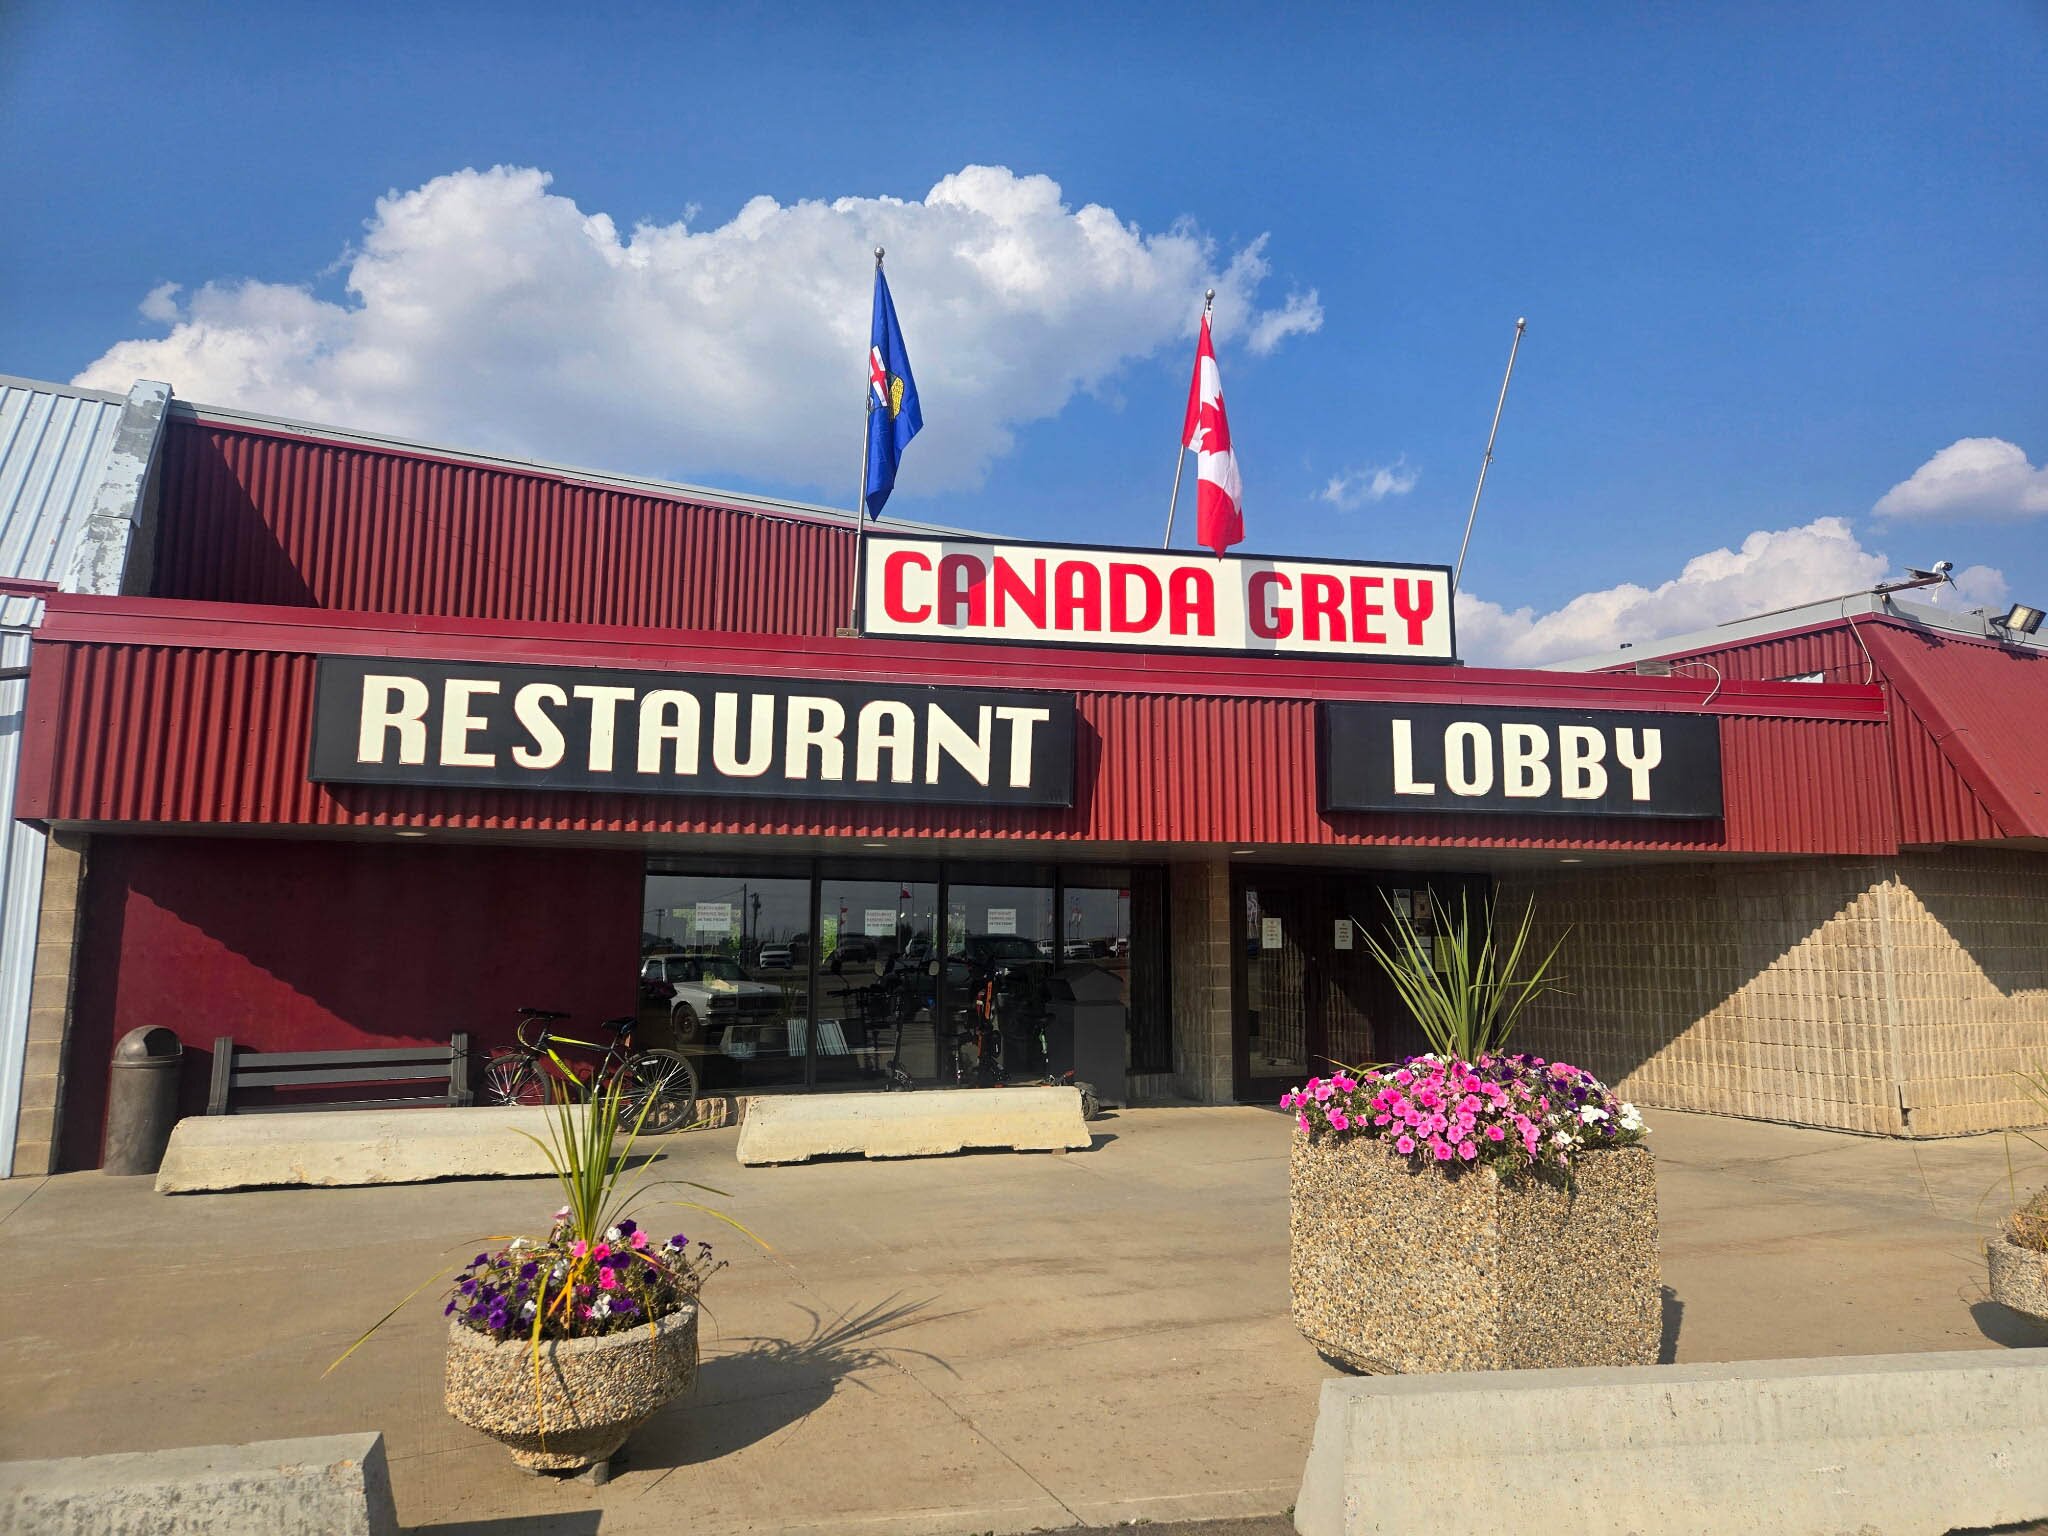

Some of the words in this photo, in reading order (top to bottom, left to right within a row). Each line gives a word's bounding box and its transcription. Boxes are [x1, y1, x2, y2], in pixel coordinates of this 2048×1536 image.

[884, 550, 1216, 637] CANADA
[1248, 570, 1434, 647] GREY
[356, 674, 1051, 788] RESTAURANT
[1391, 719, 1662, 802] LOBBY
